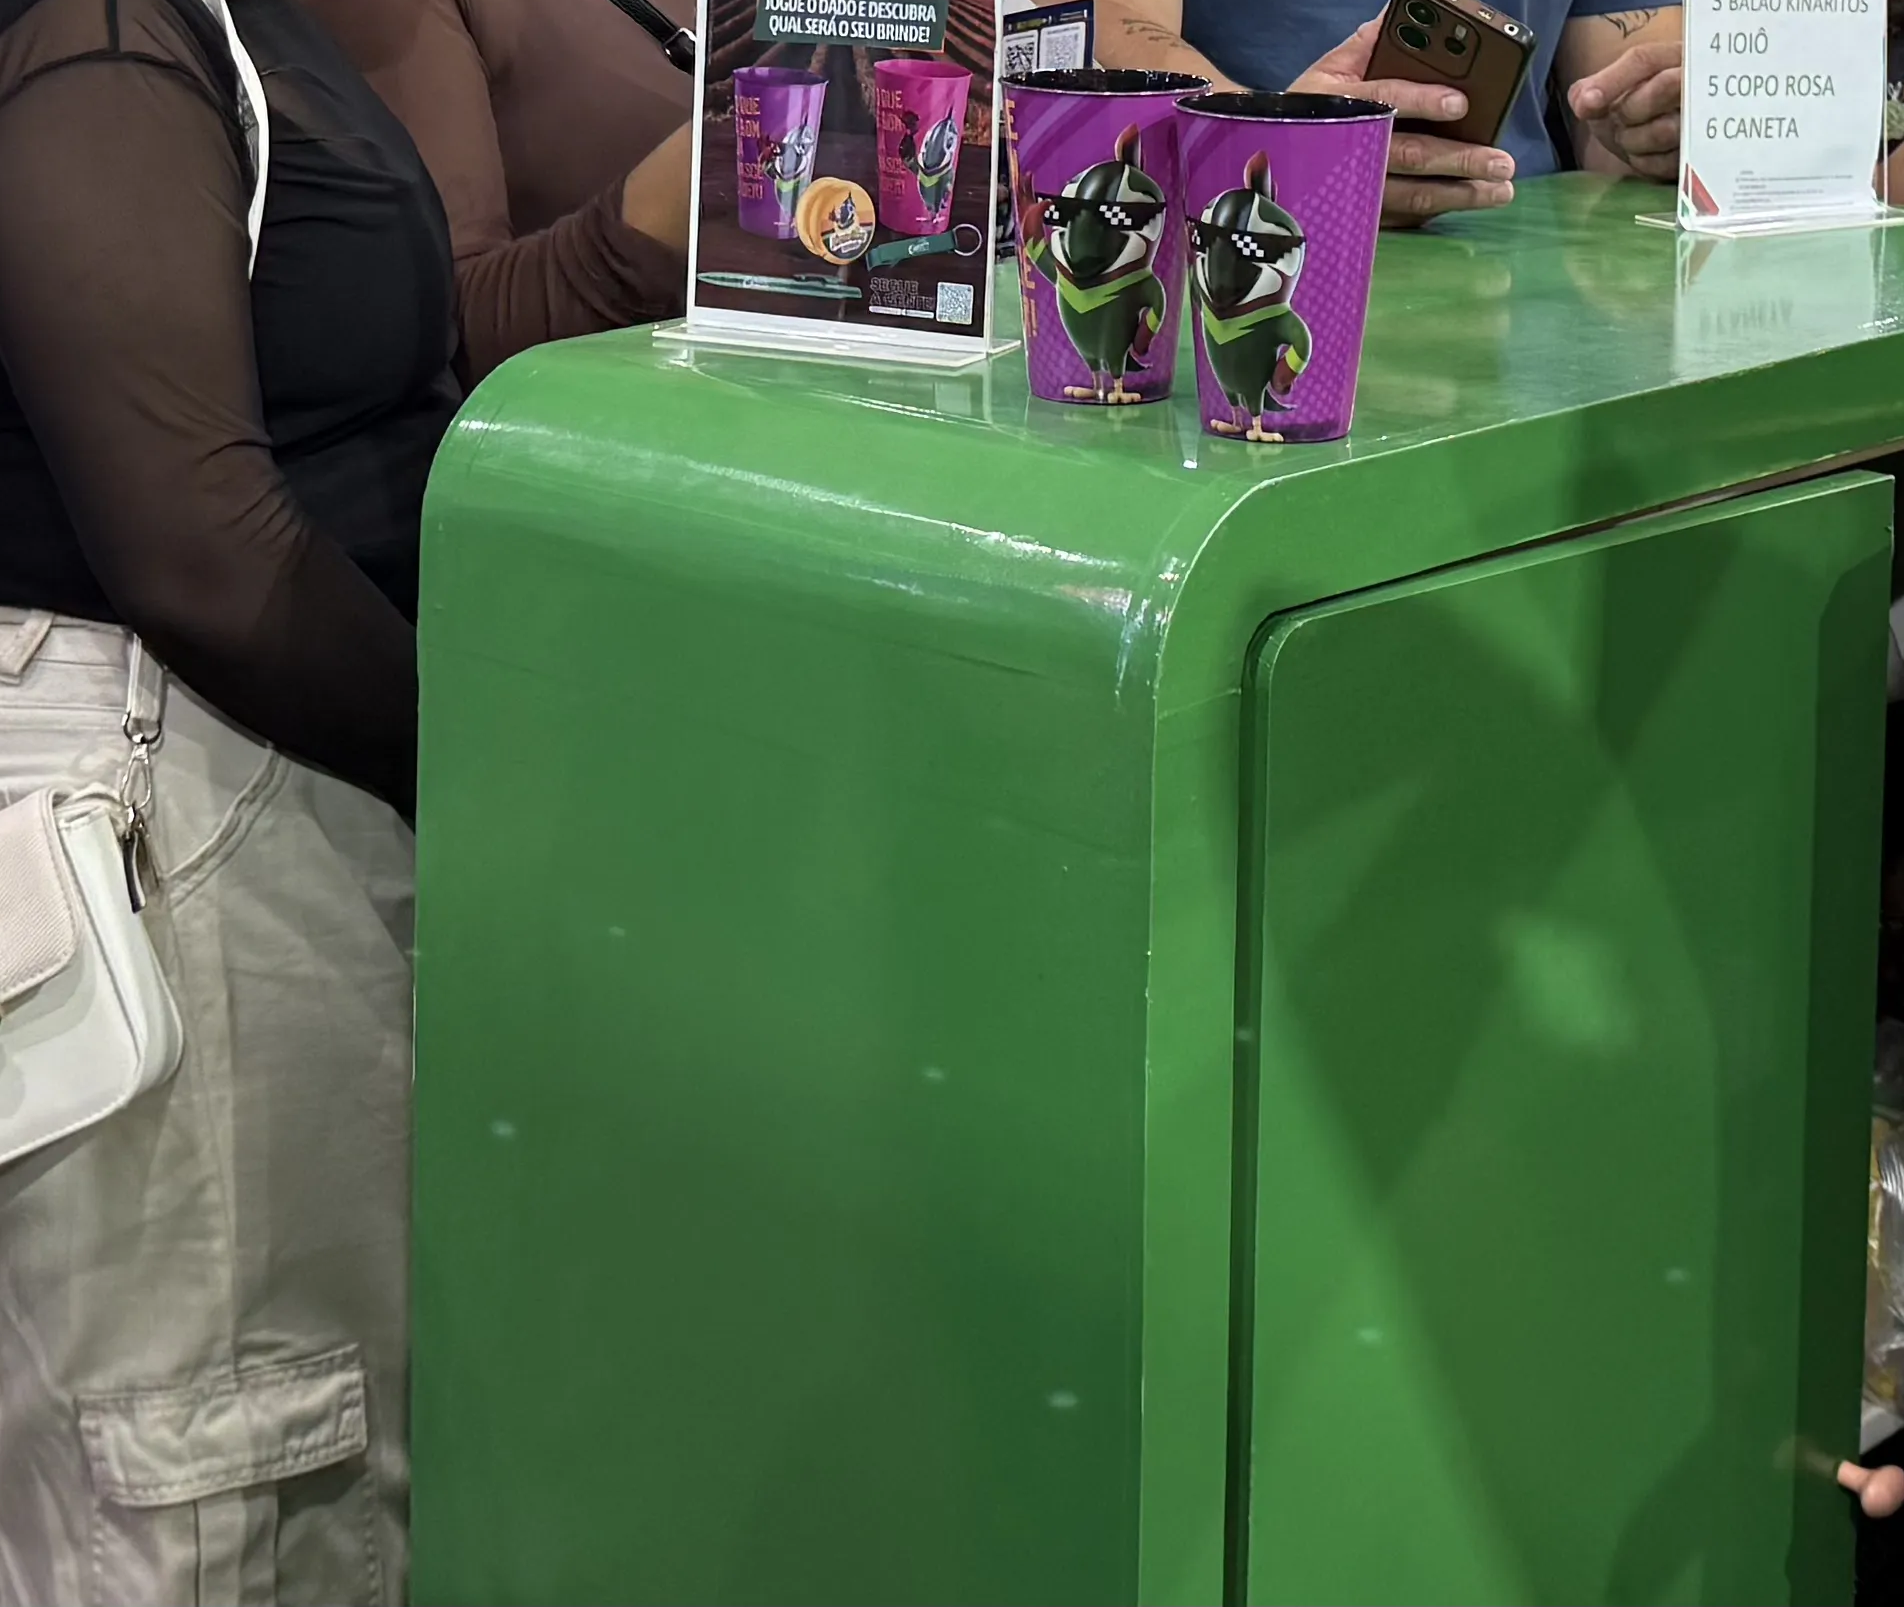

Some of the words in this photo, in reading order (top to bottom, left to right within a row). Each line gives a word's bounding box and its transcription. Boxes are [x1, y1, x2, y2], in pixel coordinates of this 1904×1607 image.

[858, 0, 866, 18] E
[868, 1, 937, 23] DESCUBRA
[769, 15, 803, 37] QUAL
[804, 11, 837, 37] SERÁ
[838, 18, 847, 37] O
[849, 20, 875, 39] SEU
[876, 24, 930, 44] BRINDE!
[1710, 32, 1721, 54] 4
[1728, 27, 1769, 54] IOIÔ
[1708, 75, 1718, 97] 5
[1724, 75, 1779, 97] COPO
[1785, 75, 1835, 97] ROSA
[1706, 117, 1717, 139] 6
[1723, 117, 1799, 139] CANETA
